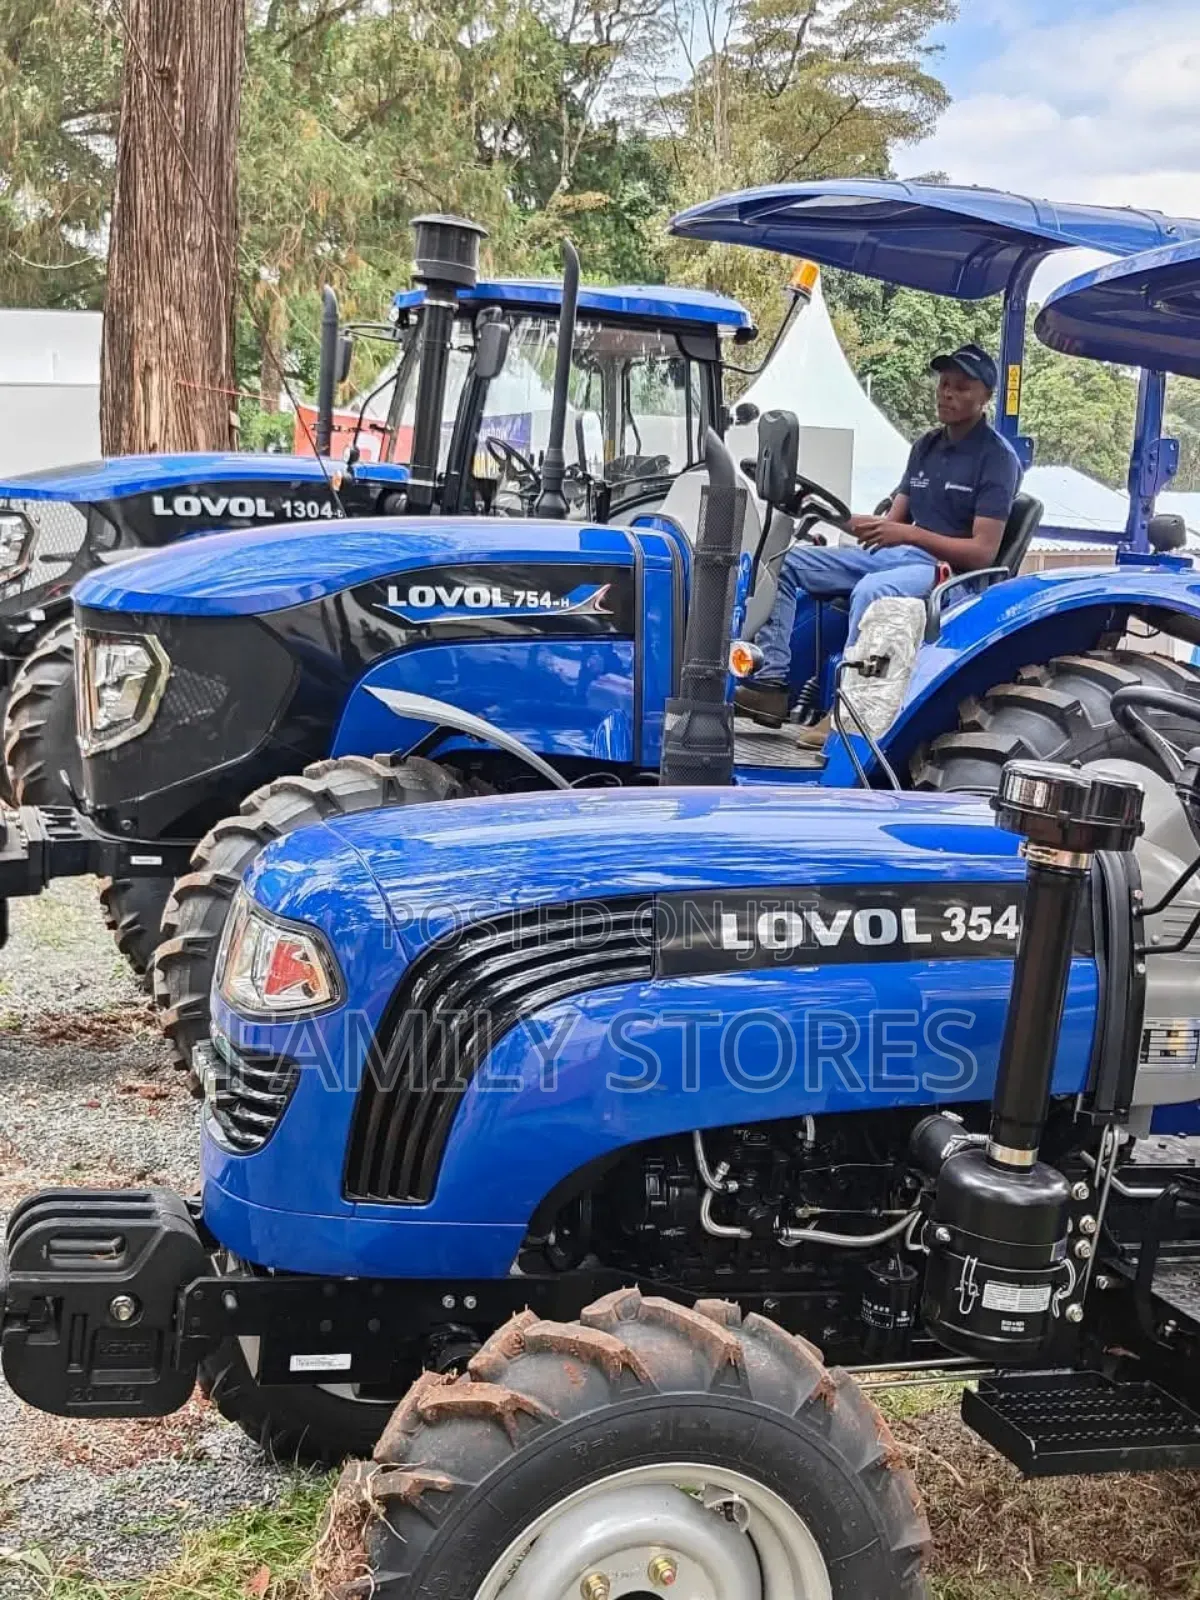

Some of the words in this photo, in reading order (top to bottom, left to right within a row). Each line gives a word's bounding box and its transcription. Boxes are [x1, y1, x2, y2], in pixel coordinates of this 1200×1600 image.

[153, 495, 275, 517] LOVOL
[387, 585, 511, 608] LOVOL
[720, 907, 932, 950] LOVOL
[940, 904, 1020, 943] 354
